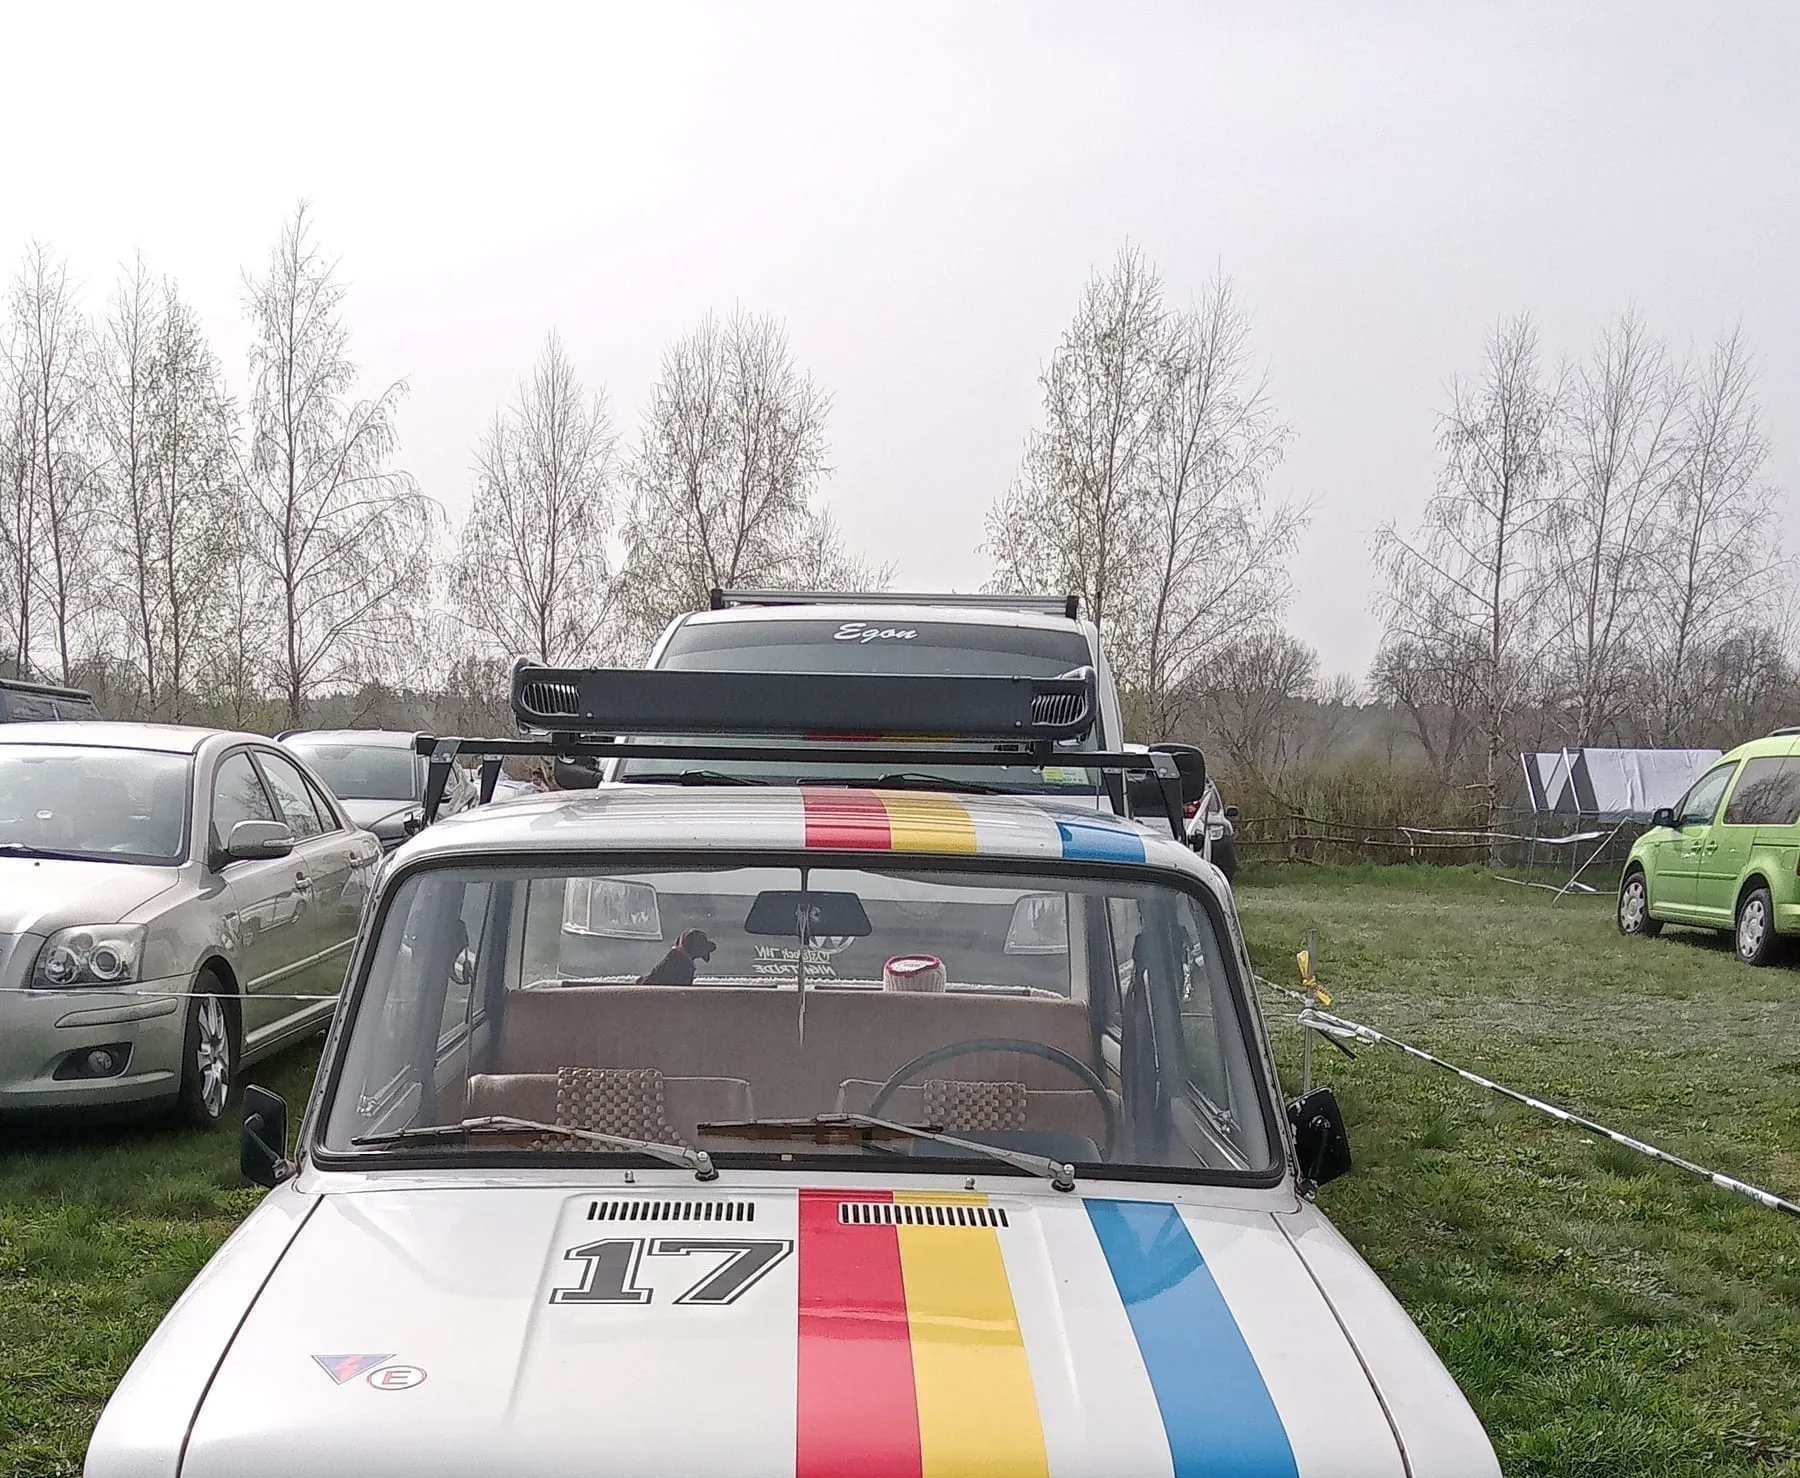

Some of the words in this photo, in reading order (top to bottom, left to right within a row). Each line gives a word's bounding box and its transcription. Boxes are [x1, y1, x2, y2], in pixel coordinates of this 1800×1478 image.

[834, 622, 918, 644] Egon
[548, 1238, 795, 1305] 17
[382, 1370, 412, 1385] E
